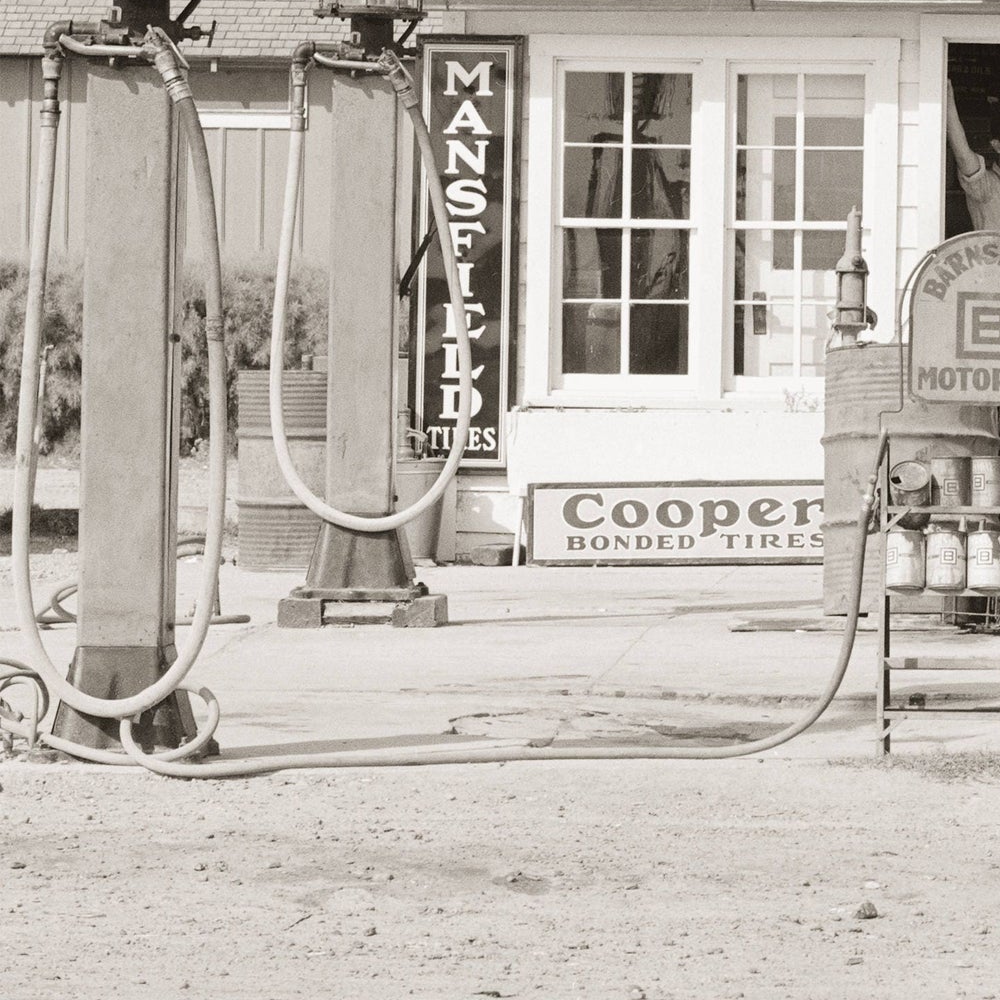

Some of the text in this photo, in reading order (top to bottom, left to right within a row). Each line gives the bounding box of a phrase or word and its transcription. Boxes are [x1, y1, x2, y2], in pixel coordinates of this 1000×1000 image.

[438, 61, 494, 420] MANSFIELD
[562, 493, 824, 537] Cooper
[566, 532, 824, 551] BONDED TIRES
